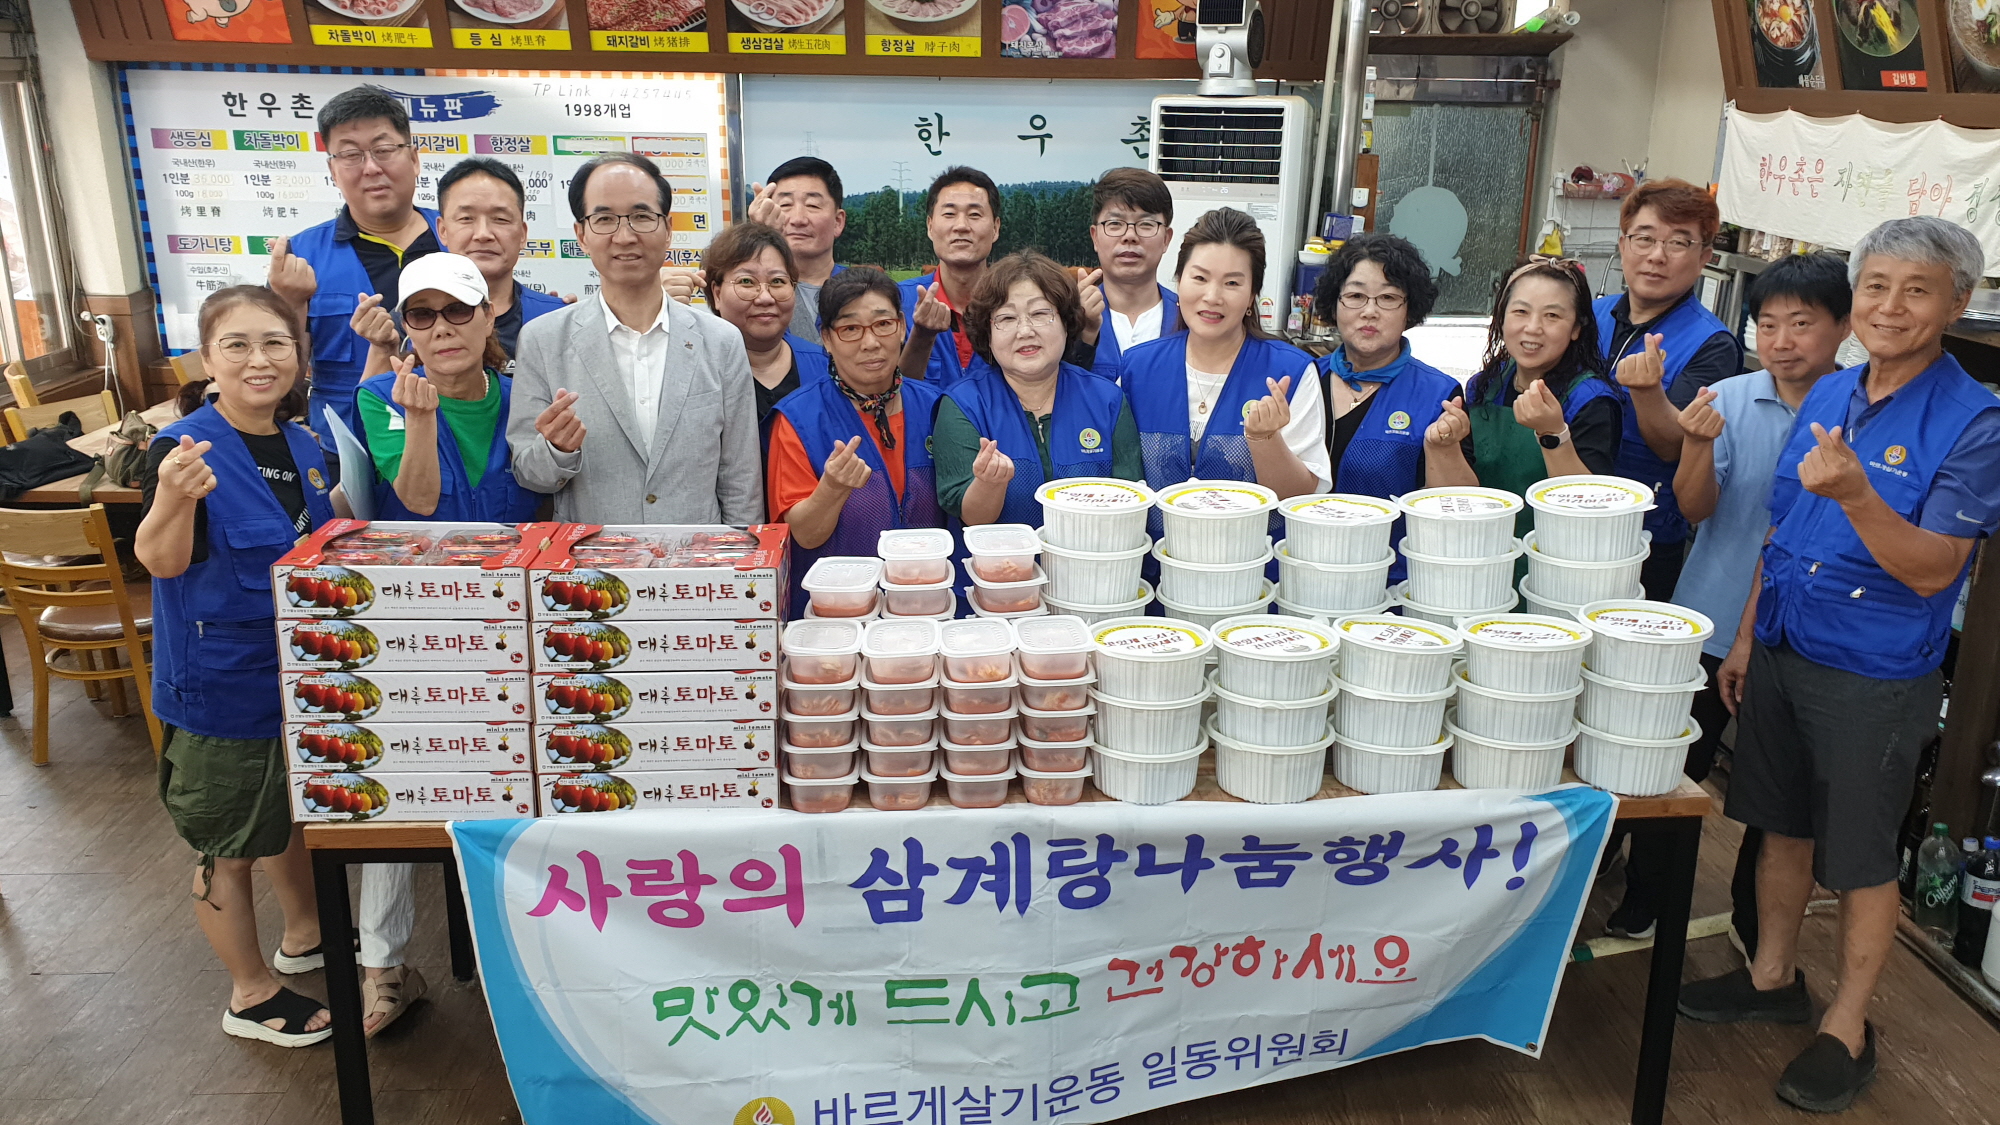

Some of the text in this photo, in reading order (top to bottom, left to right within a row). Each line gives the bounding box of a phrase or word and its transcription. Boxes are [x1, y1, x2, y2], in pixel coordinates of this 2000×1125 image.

[327, 29, 377, 43] 차돌박이
[606, 35, 650, 48] 돼지갈비
[740, 37, 784, 51] 생삼겹살
[880, 38, 915, 53] 항정살
[1891, 72, 1917, 86] 갈비탕
[559, 84, 592, 97] Link
[565, 103, 631, 118] 1998개업
[170, 131, 211, 148] 생등심
[245, 132, 300, 149] 차돌박이
[491, 136, 532, 153] 항정살
[171, 158, 216, 168] 국내산(한우)
[253, 159, 296, 169] 국내산(한우)
[422, 162, 445, 172] 국내산
[162, 173, 190, 185] 1인분
[244, 174, 271, 186] 1인분
[1759, 153, 1825, 199] 한우촌은
[1907, 171, 1953, 217] 담아
[175, 189, 194, 198] 100g
[256, 190, 274, 199] 100g
[178, 237, 233, 252] 도가니탕
[282, 470, 297, 482] ON
[526, 843, 805, 933] 사랑의
[1926, 874, 1958, 908] Chilsung
[1974, 883, 2000, 895] PEPS
[653, 932, 1418, 1047] 맛있게 드시고 건강하세요
[814, 1028, 1349, 1125] 바르게살기운동 일동위원회
